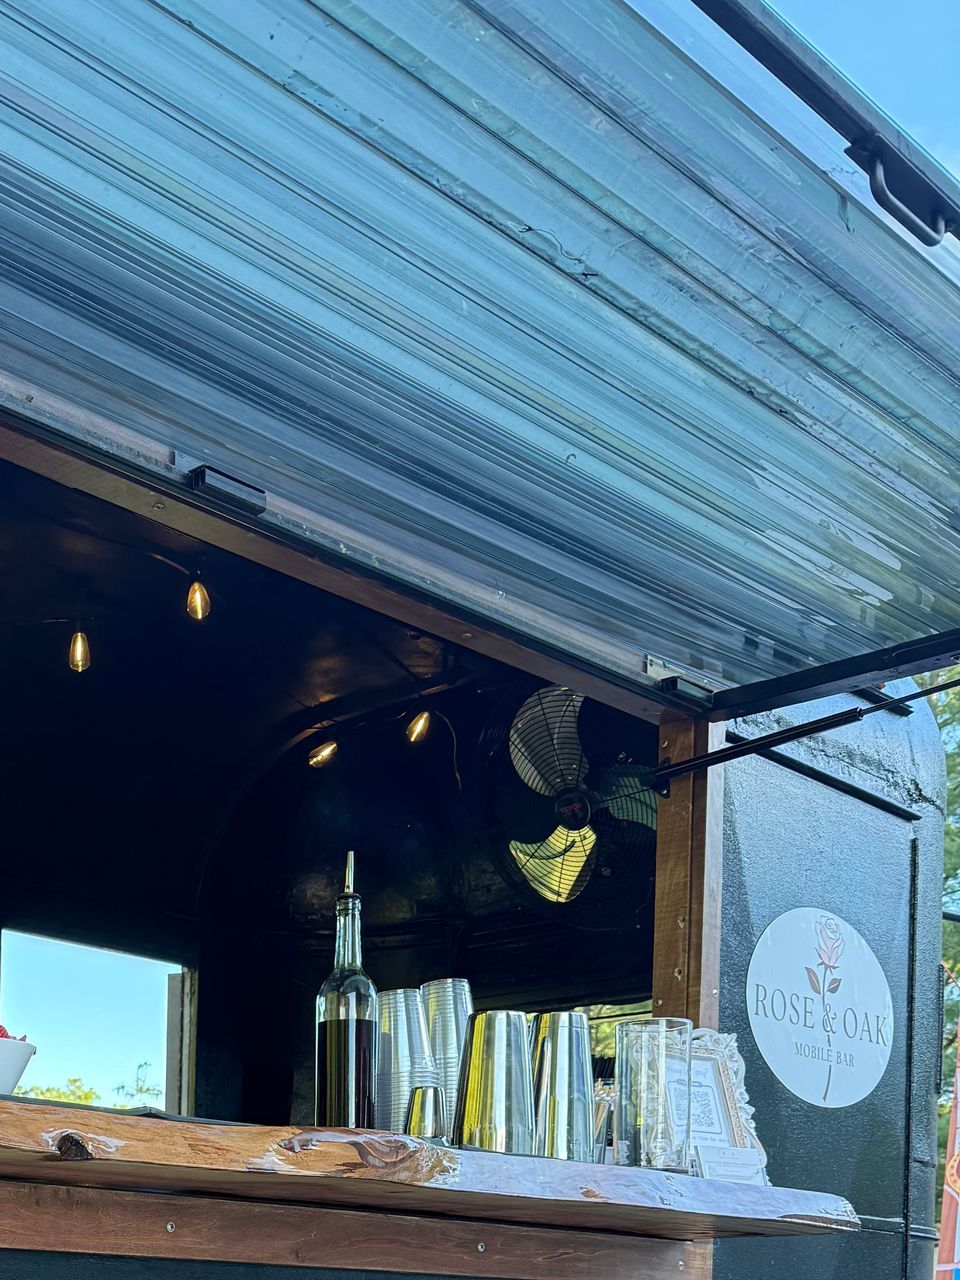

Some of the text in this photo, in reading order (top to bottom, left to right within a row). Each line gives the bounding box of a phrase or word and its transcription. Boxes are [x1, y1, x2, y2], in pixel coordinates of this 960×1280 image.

[754, 983, 888, 1047] ROSE & OAK
[794, 1041, 855, 1068] MOBILE BAR
